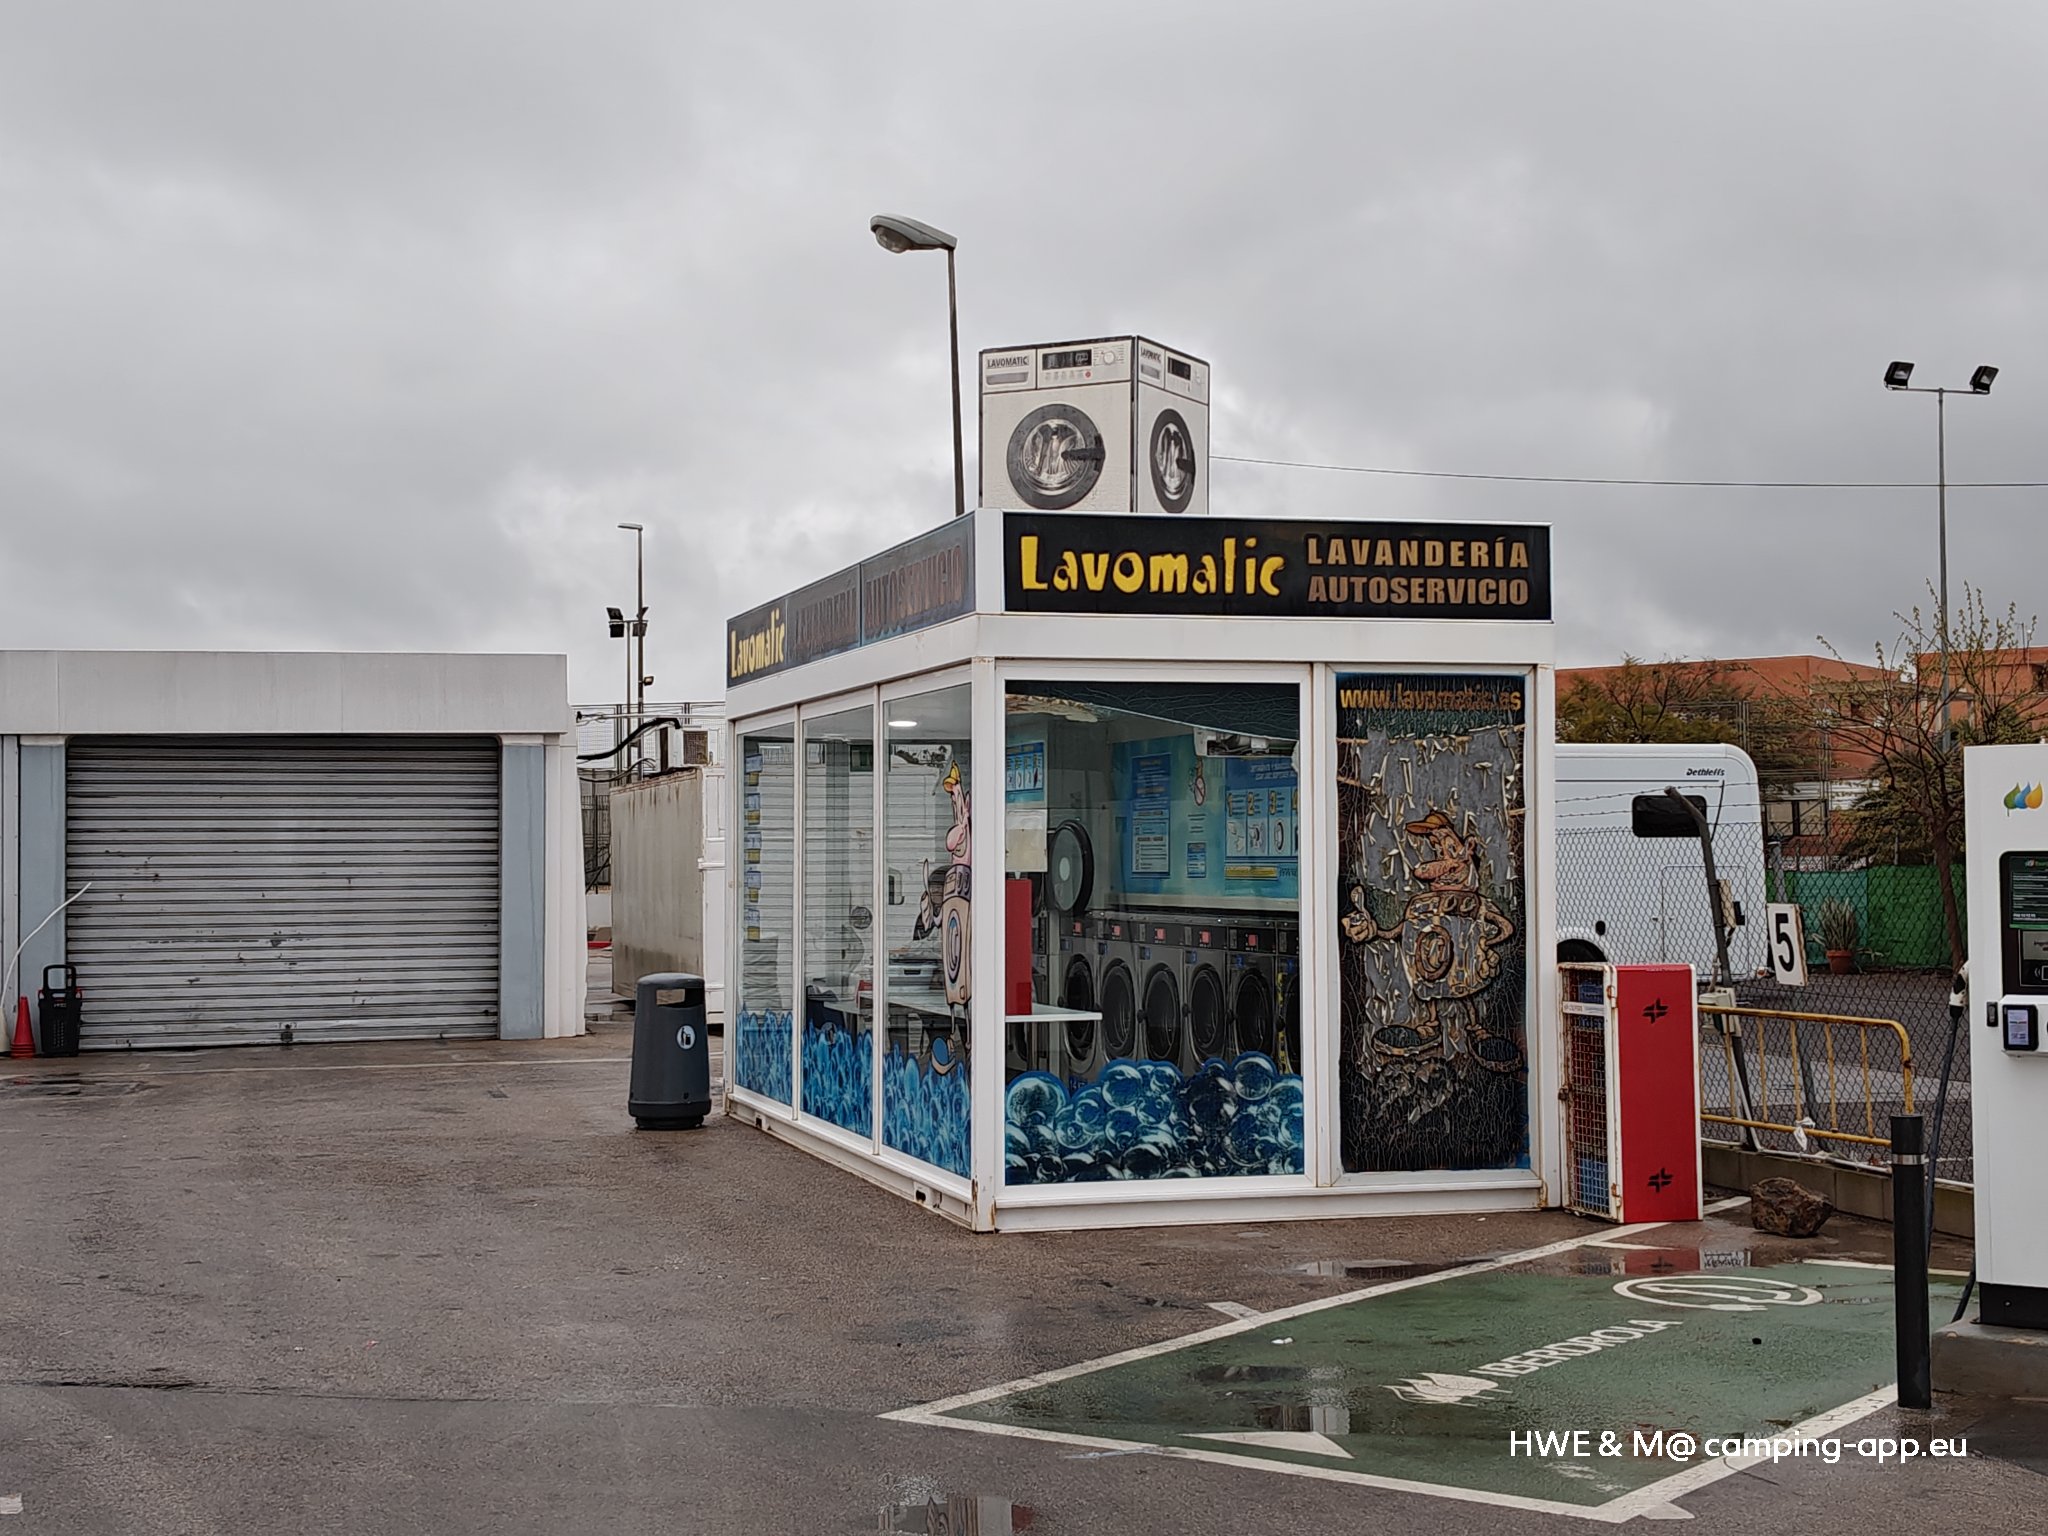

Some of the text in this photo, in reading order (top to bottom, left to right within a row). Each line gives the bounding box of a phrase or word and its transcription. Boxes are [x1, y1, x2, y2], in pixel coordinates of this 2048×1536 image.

[986, 355, 1030, 369] LAVOMATIC
[1307, 536, 1529, 568] LAVANDERÍA
[1307, 575, 1529, 606] AUTOSERVICIO
[1686, 767, 1725, 776] Dethleffs
[1775, 913, 1795, 972] 5
[1468, 1318, 1684, 1378] IBERDROLA
